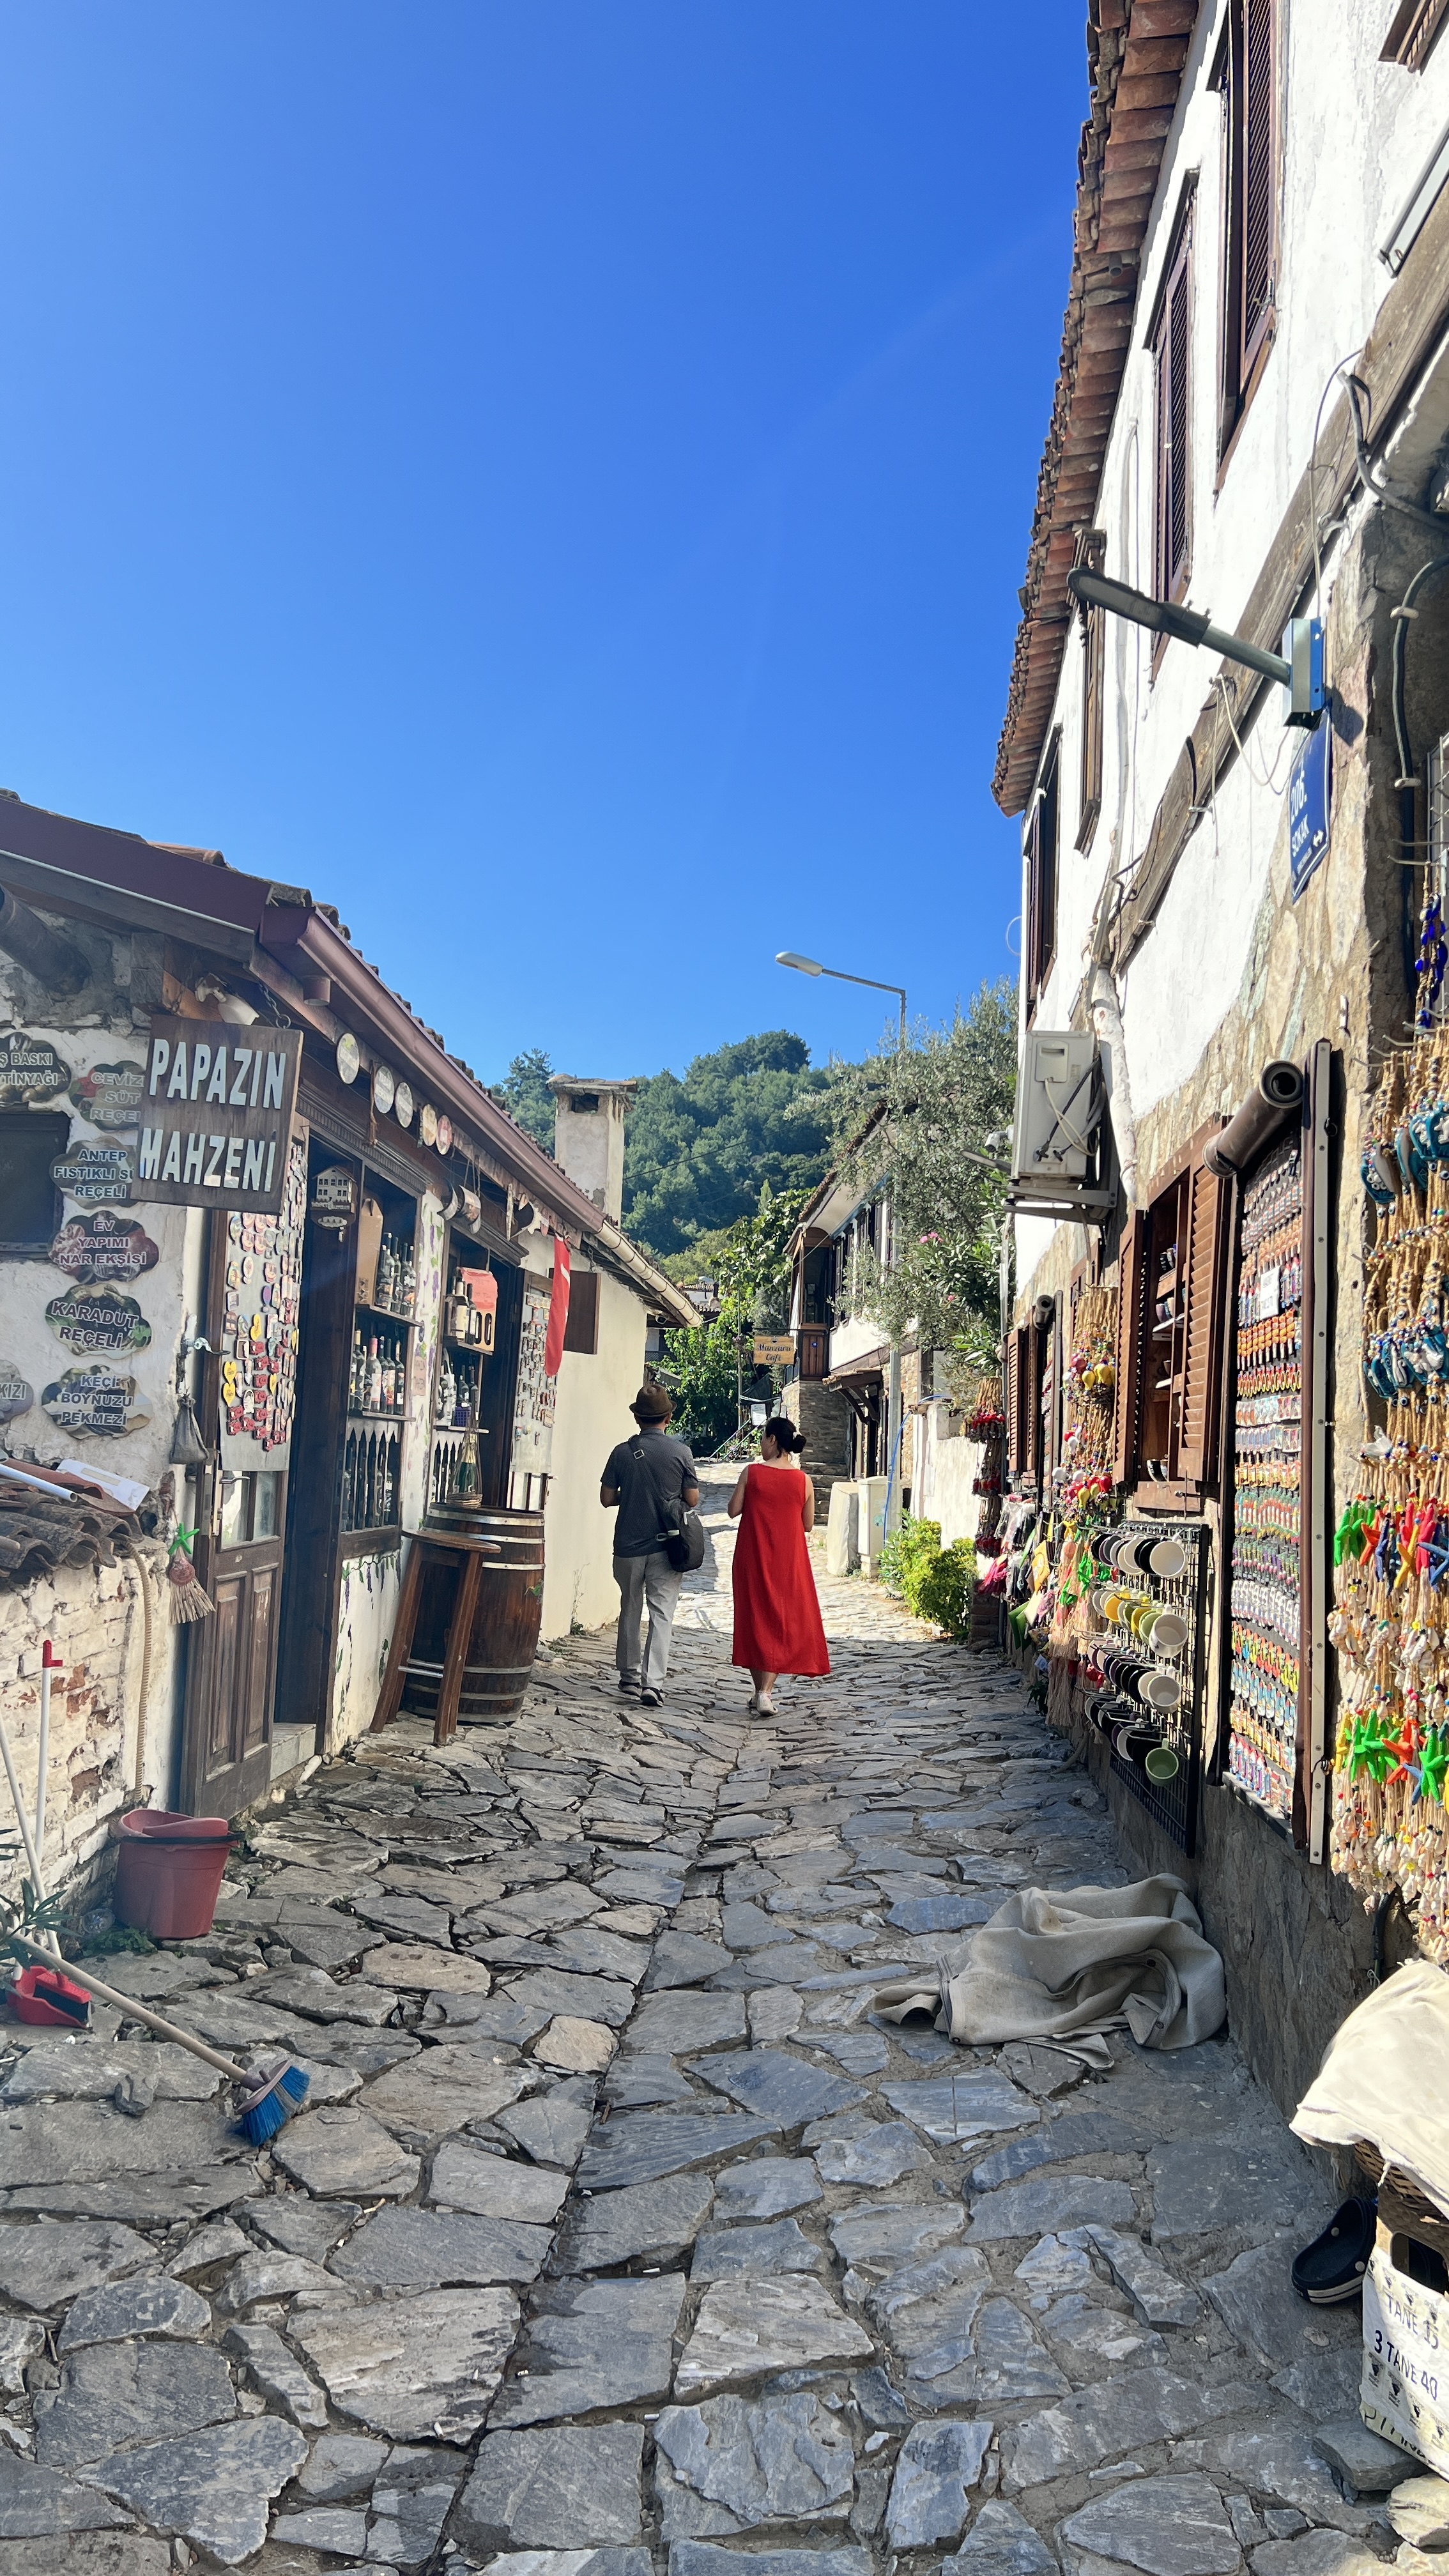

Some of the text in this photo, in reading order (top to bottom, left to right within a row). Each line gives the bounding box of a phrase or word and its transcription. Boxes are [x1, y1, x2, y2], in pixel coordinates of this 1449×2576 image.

[1291, 813, 1310, 858] SOKAK
[11, 1052, 53, 1066] BASKI
[0, 1070, 58, 1085] TİNYAĞI
[90, 1071, 145, 1087] CEVİZ
[148, 1038, 286, 1110] PAPAZIN
[104, 1090, 141, 1105] SÜT
[77, 1149, 128, 1162] ANTEP
[54, 1166, 116, 1181] FISTIKLI
[73, 1184, 127, 1200] REÇELİ
[93, 1220, 116, 1232] EV
[77, 1237, 130, 1248] YAPIMI
[59, 1252, 148, 1267] NAR EKŞİSİ
[51, 1300, 140, 1329] KARADUT
[59, 1325, 124, 1350] REÇELİ
[759, 1343, 792, 1352] Manzara
[80, 1374, 118, 1391] KEÇİ
[61, 1392, 134, 1407] BOYNUZU
[61, 1411, 127, 1426] PEKMEZİ
[1383, 2288, 1419, 2336] TANE
[1374, 2329, 1383, 2354] 3
[1386, 2341, 1418, 2386] TANE
[1420, 2370, 1438, 2402] 40
